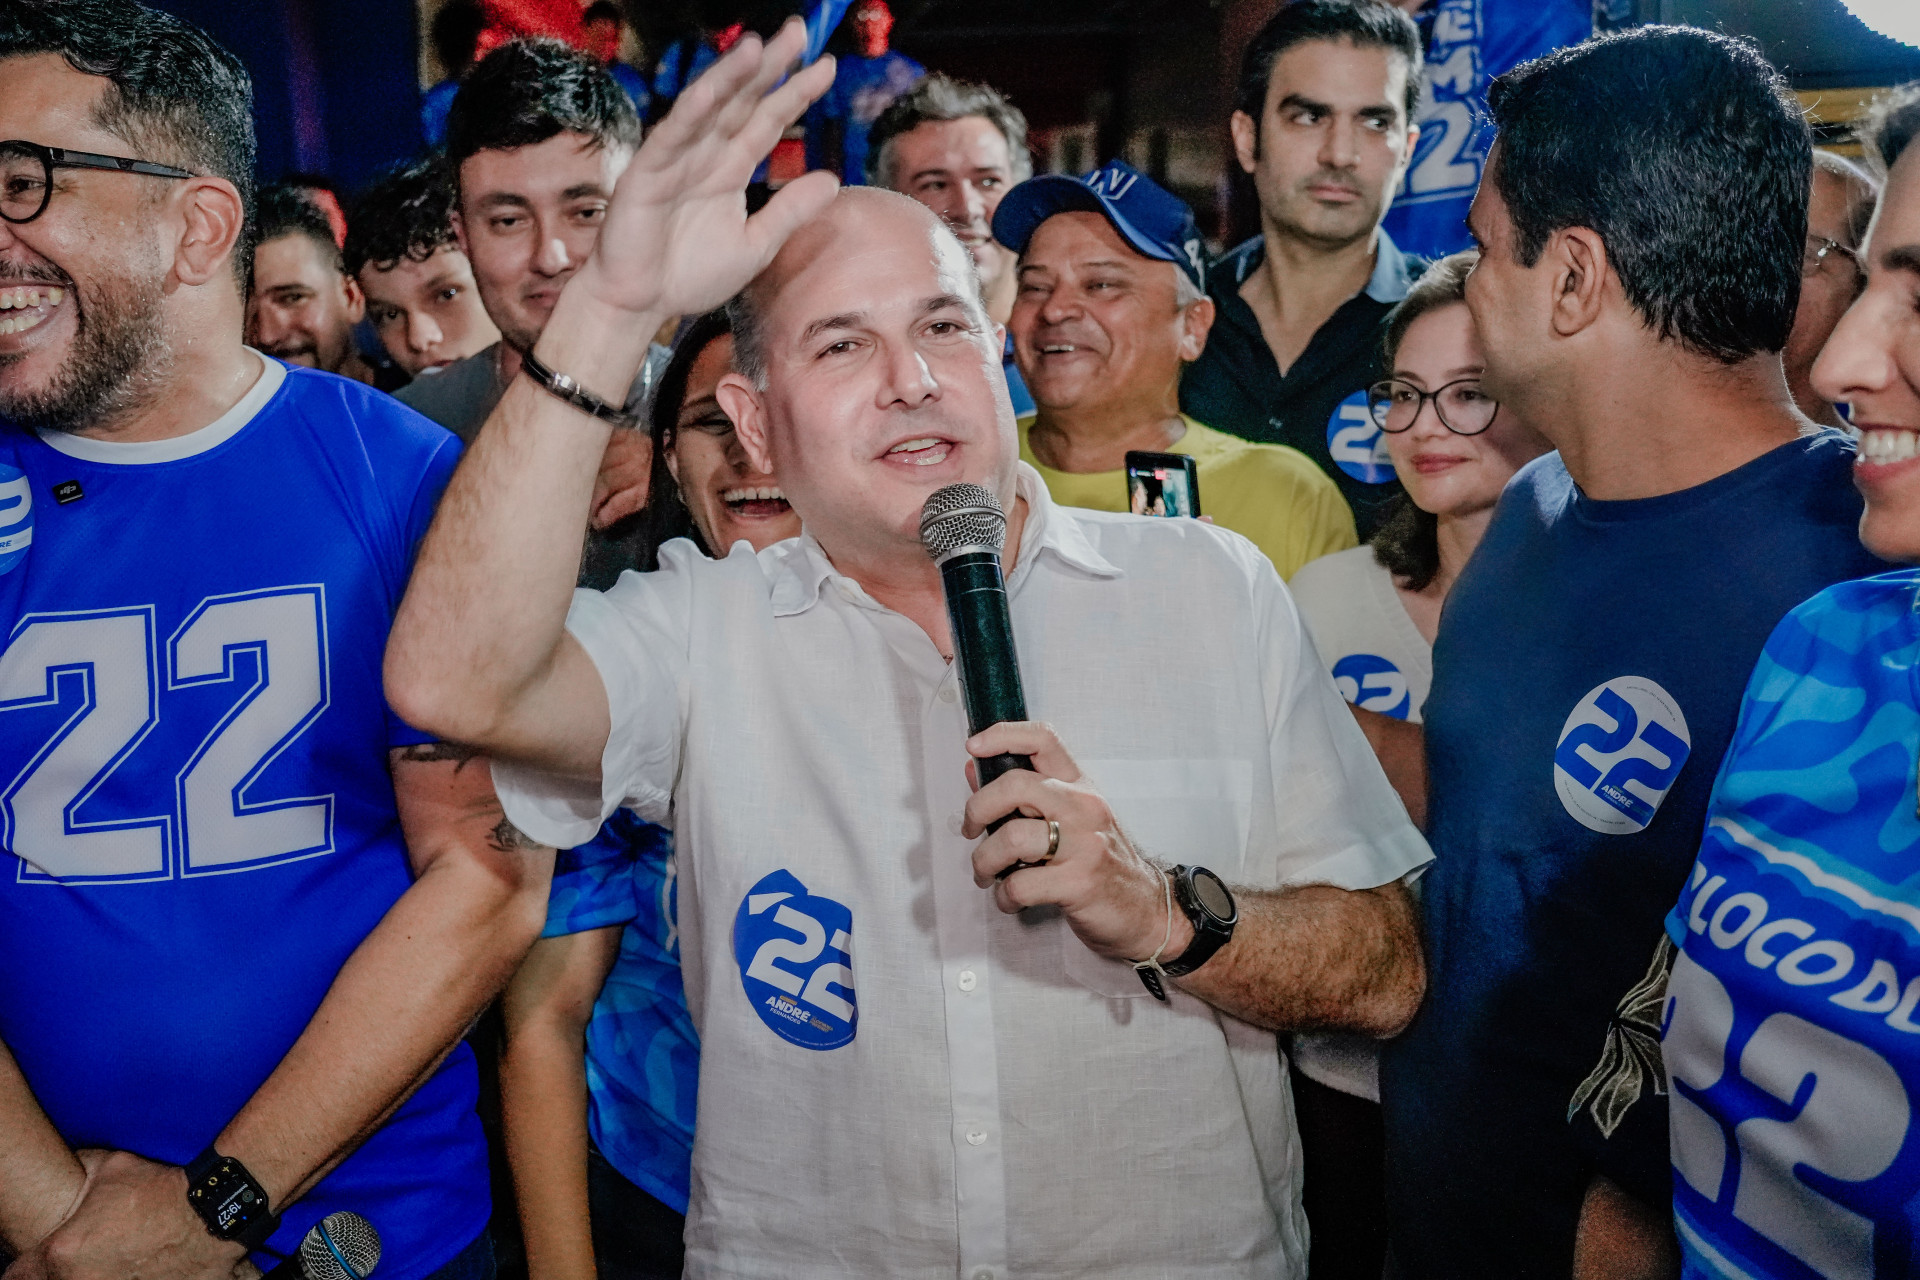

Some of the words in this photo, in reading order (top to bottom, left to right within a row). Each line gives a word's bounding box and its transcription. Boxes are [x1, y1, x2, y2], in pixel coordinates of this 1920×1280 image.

[0, 583, 335, 886] 22
[1554, 687, 1690, 828] 22
[1689, 861, 1855, 986] LOCO
[765, 995, 811, 1023] ANDRÉ
[217, 1201, 242, 1226] 19:27
